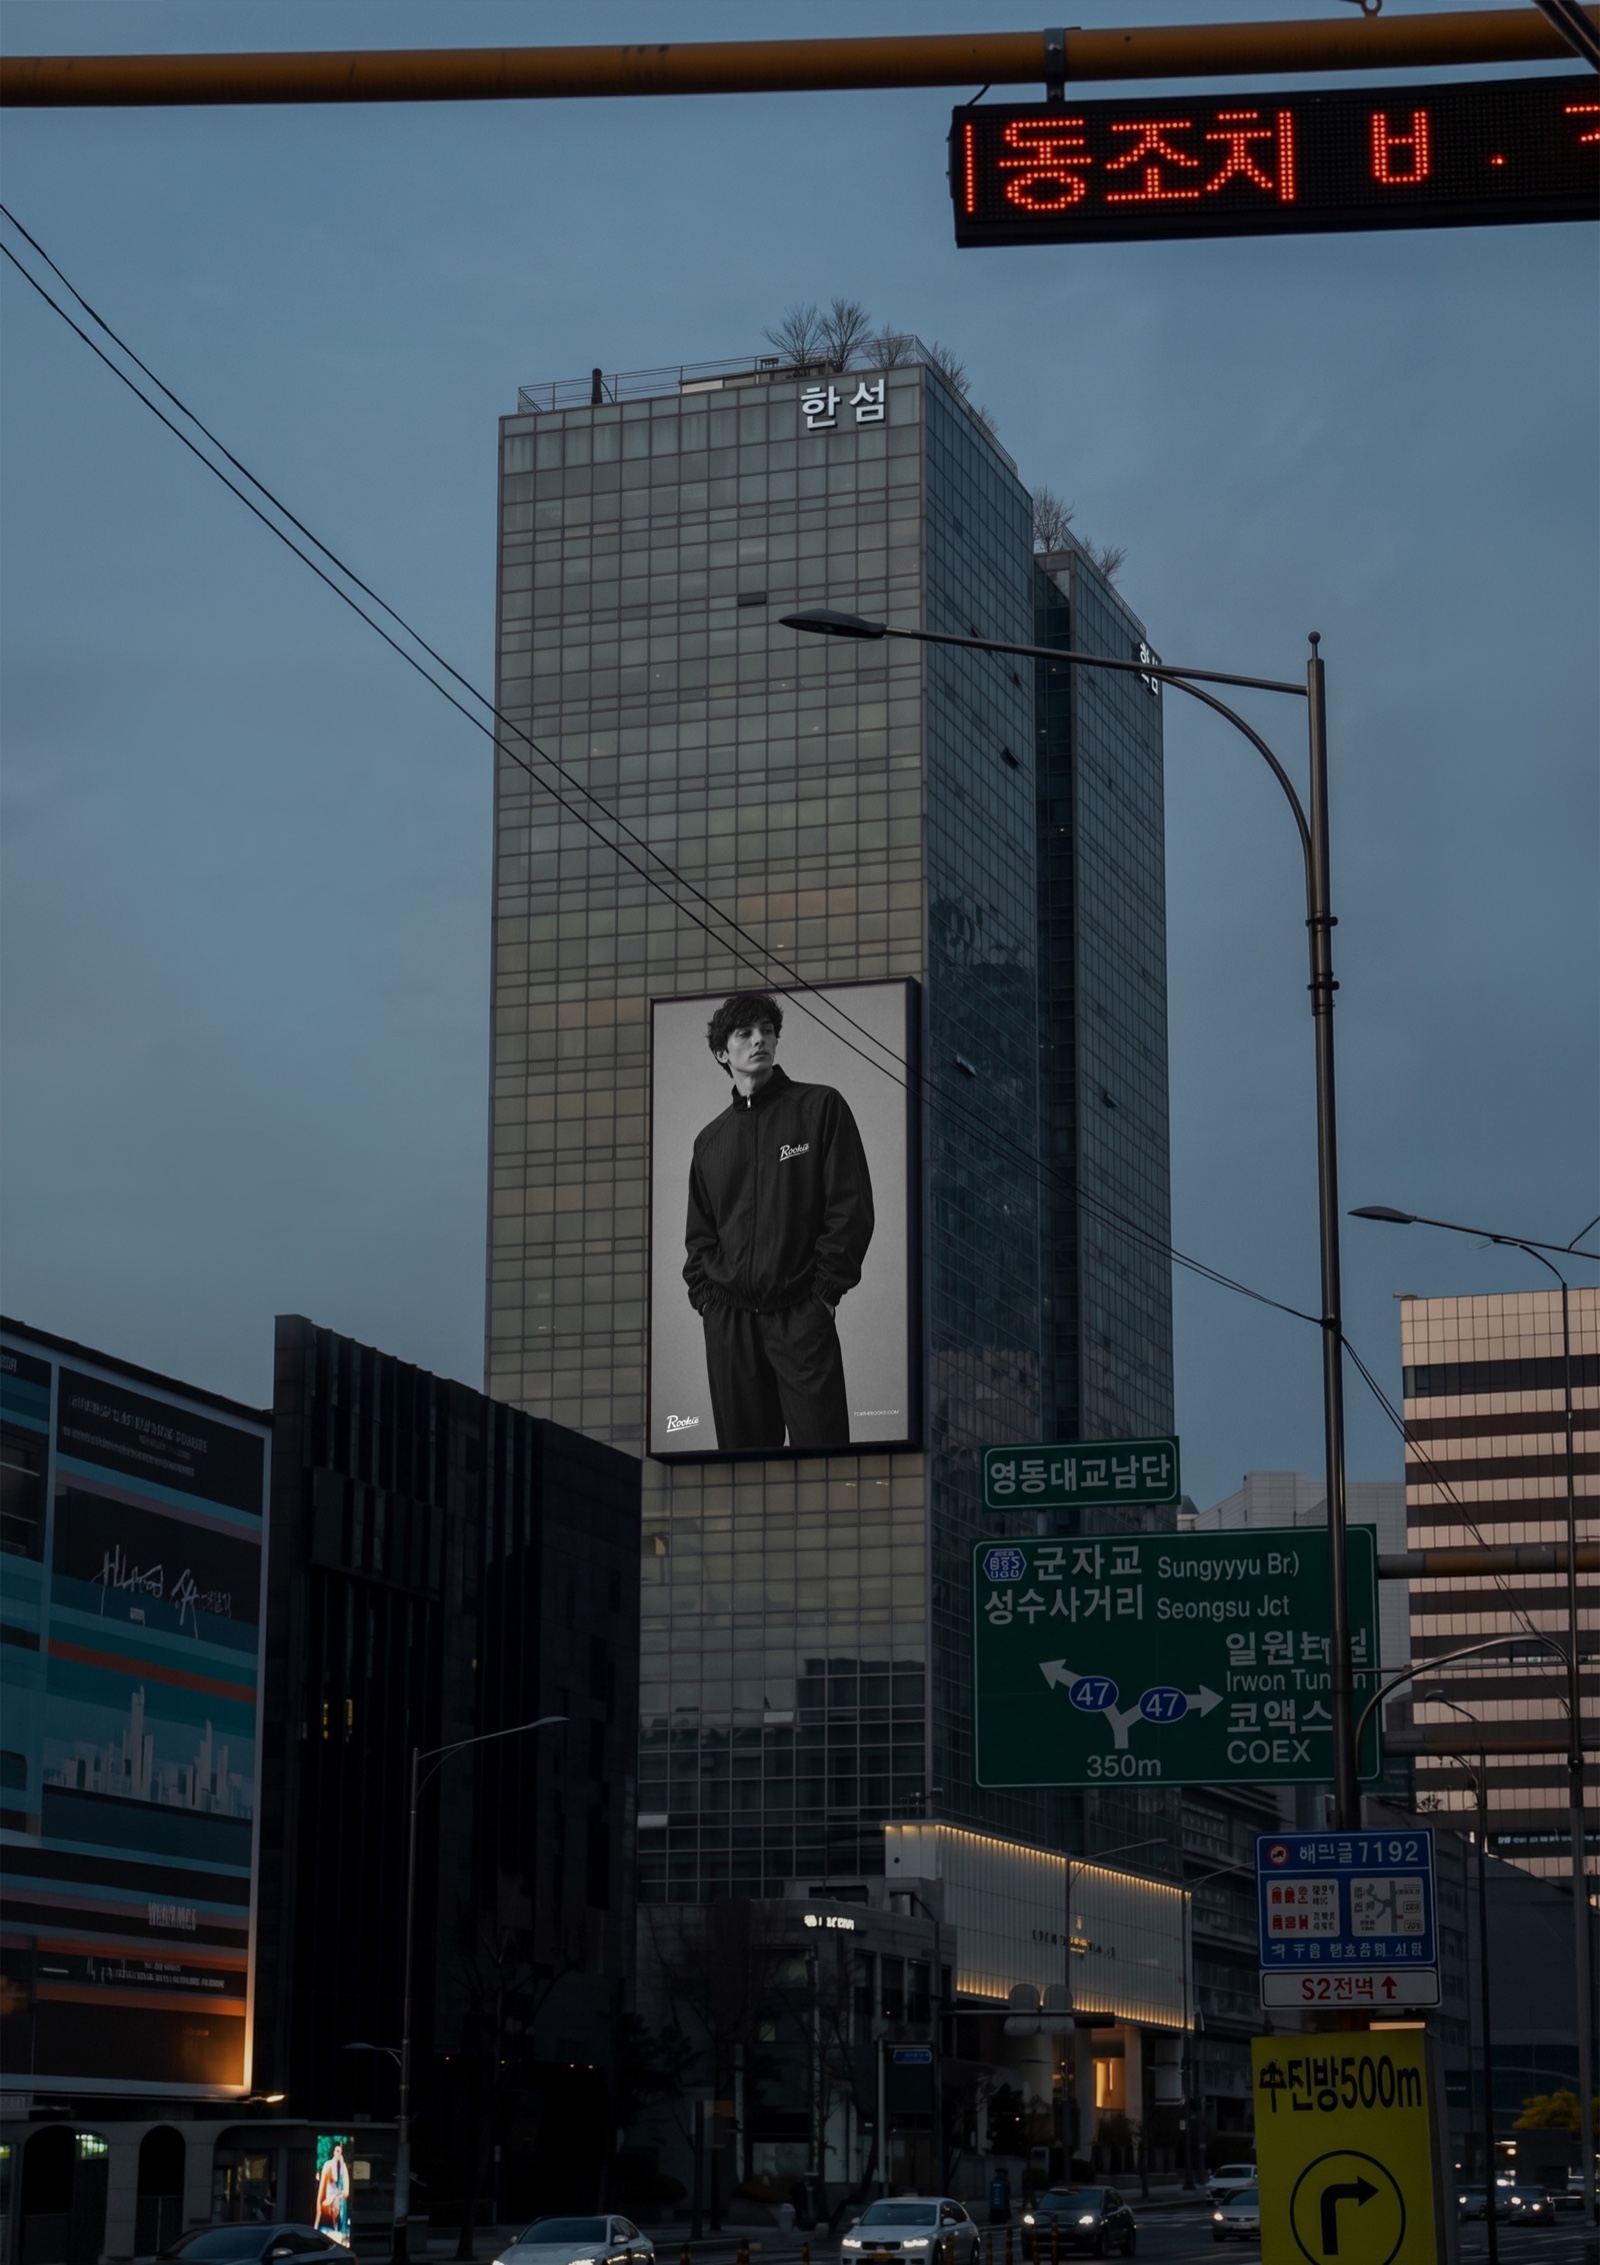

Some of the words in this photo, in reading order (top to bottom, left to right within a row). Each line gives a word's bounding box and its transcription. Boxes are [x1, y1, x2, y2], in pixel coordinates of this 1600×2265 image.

[990, 1453, 1171, 1494] 영동대교남단
[1033, 1544, 1142, 1581] 군자교
[1267, 1551, 1300, 1577] Br.)
[983, 1584, 1143, 1625] 성수사거리
[1157, 1597, 1250, 1623] Seongsu
[1257, 1594, 1290, 1617] Jct
[1226, 1671, 1285, 1692] Irwon
[1076, 1682, 1110, 1706] 47
[1145, 1693, 1179, 1717] 47
[1227, 1699, 1333, 1735] 코액스
[1227, 1739, 1312, 1764] COEX
[1086, 1754, 1162, 1777] 350m
[1358, 1840, 1419, 1863] 7192
